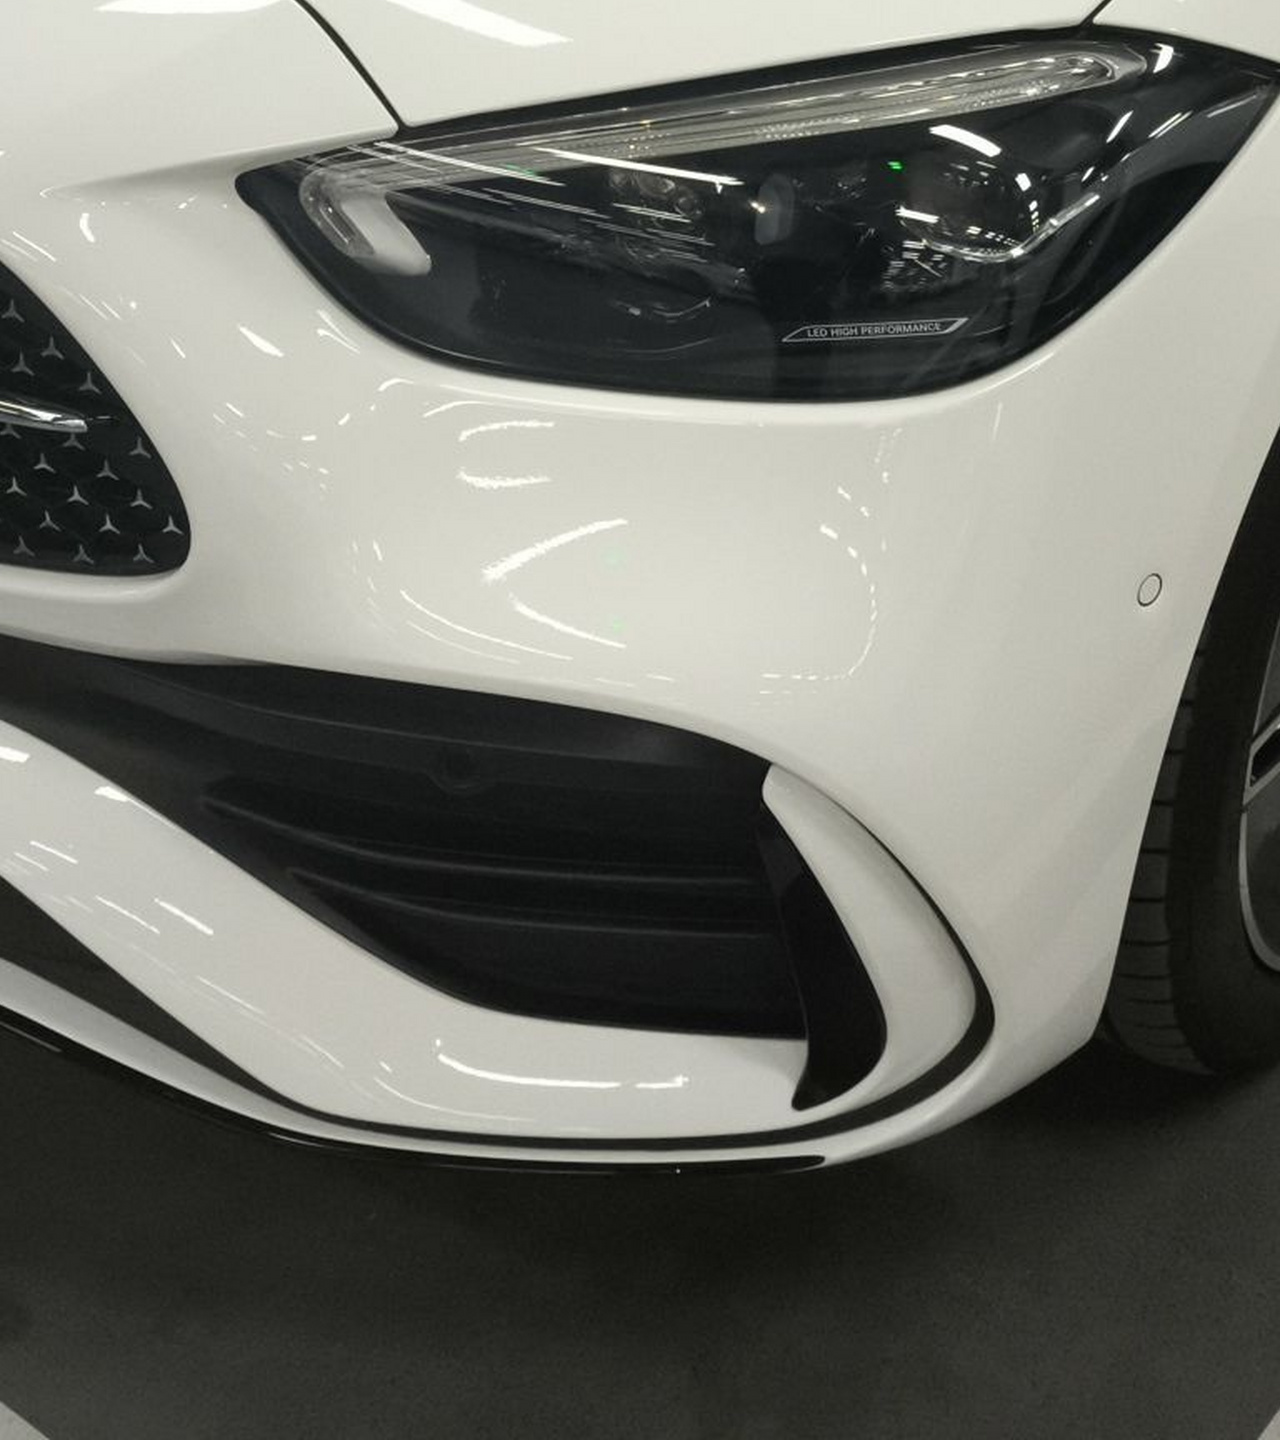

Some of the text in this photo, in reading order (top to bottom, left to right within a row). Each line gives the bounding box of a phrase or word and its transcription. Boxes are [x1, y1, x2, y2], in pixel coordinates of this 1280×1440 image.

[807, 322, 941, 338] LED HIGH PERFORMANCE
